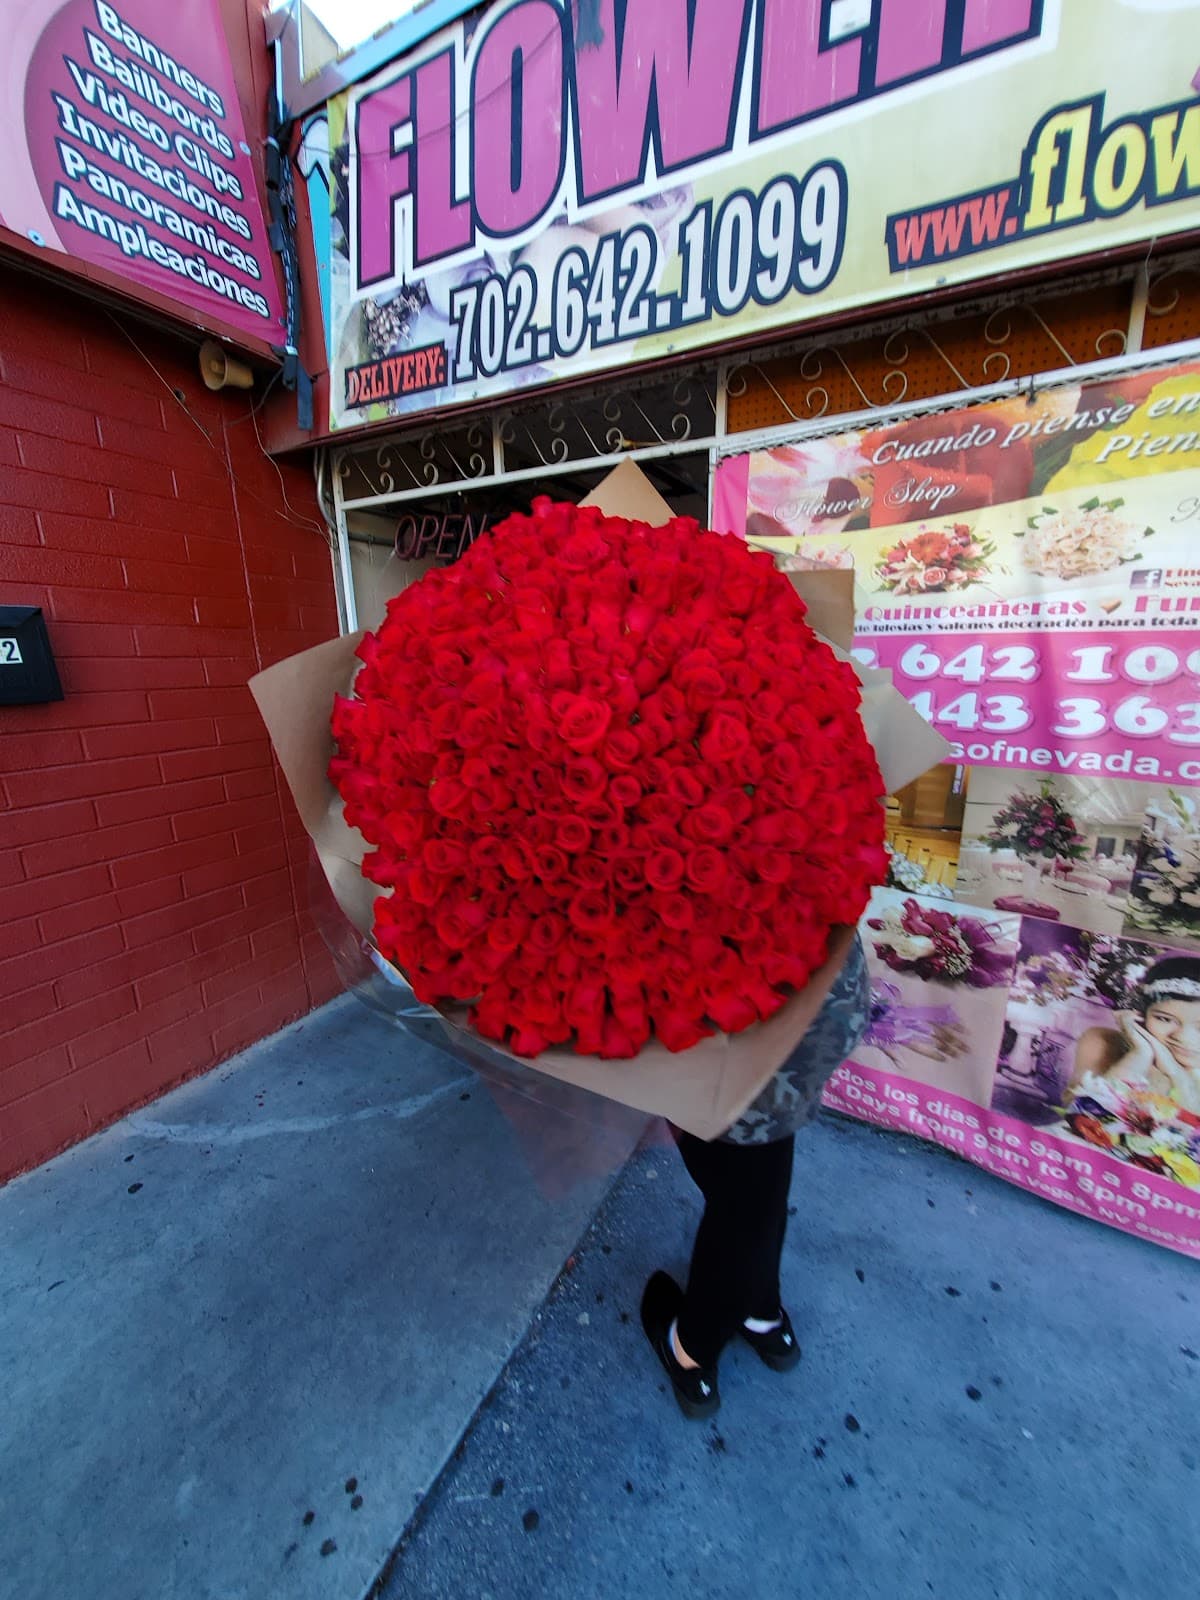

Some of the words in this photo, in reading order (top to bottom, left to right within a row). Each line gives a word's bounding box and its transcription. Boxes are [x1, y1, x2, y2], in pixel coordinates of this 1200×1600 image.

[85, 29, 234, 159] Bailbords
[95, 0, 225, 118] Banners
[54, 95, 252, 240] Invitaciones
[66, 57, 172, 152] Video
[173, 133, 244, 199] Clips
[55, 185, 270, 318] Ampleaciones
[58, 141, 262, 280] Panoramicas
[346, 345, 446, 405] DELIVERY:
[451, 162, 845, 380] 702.642.1099
[872, 424, 995, 465] Cuando
[1001, 402, 1136, 448] piense
[1148, 393, 1200, 419] en
[1095, 430, 1200, 463] Pien
[394, 513, 488, 559] OPEN
[884, 477, 965, 511] Shop
[900, 643, 1037, 683] 642
[1098, 617, 1146, 628] para
[846, 1084, 900, 1117] Days
[908, 1107, 965, 1142] from
[973, 1132, 1030, 1168] 9am
[1039, 1161, 1069, 1181] to
[1077, 1176, 1146, 1217] 8pm
[884, 1083, 920, 1106] los
[926, 1100, 980, 1129] dias
[987, 1126, 1022, 1148] de
[1030, 1140, 1093, 1175] 9am
[1102, 1171, 1121, 1188] a
[1098, 1206, 1130, 1224] NV
